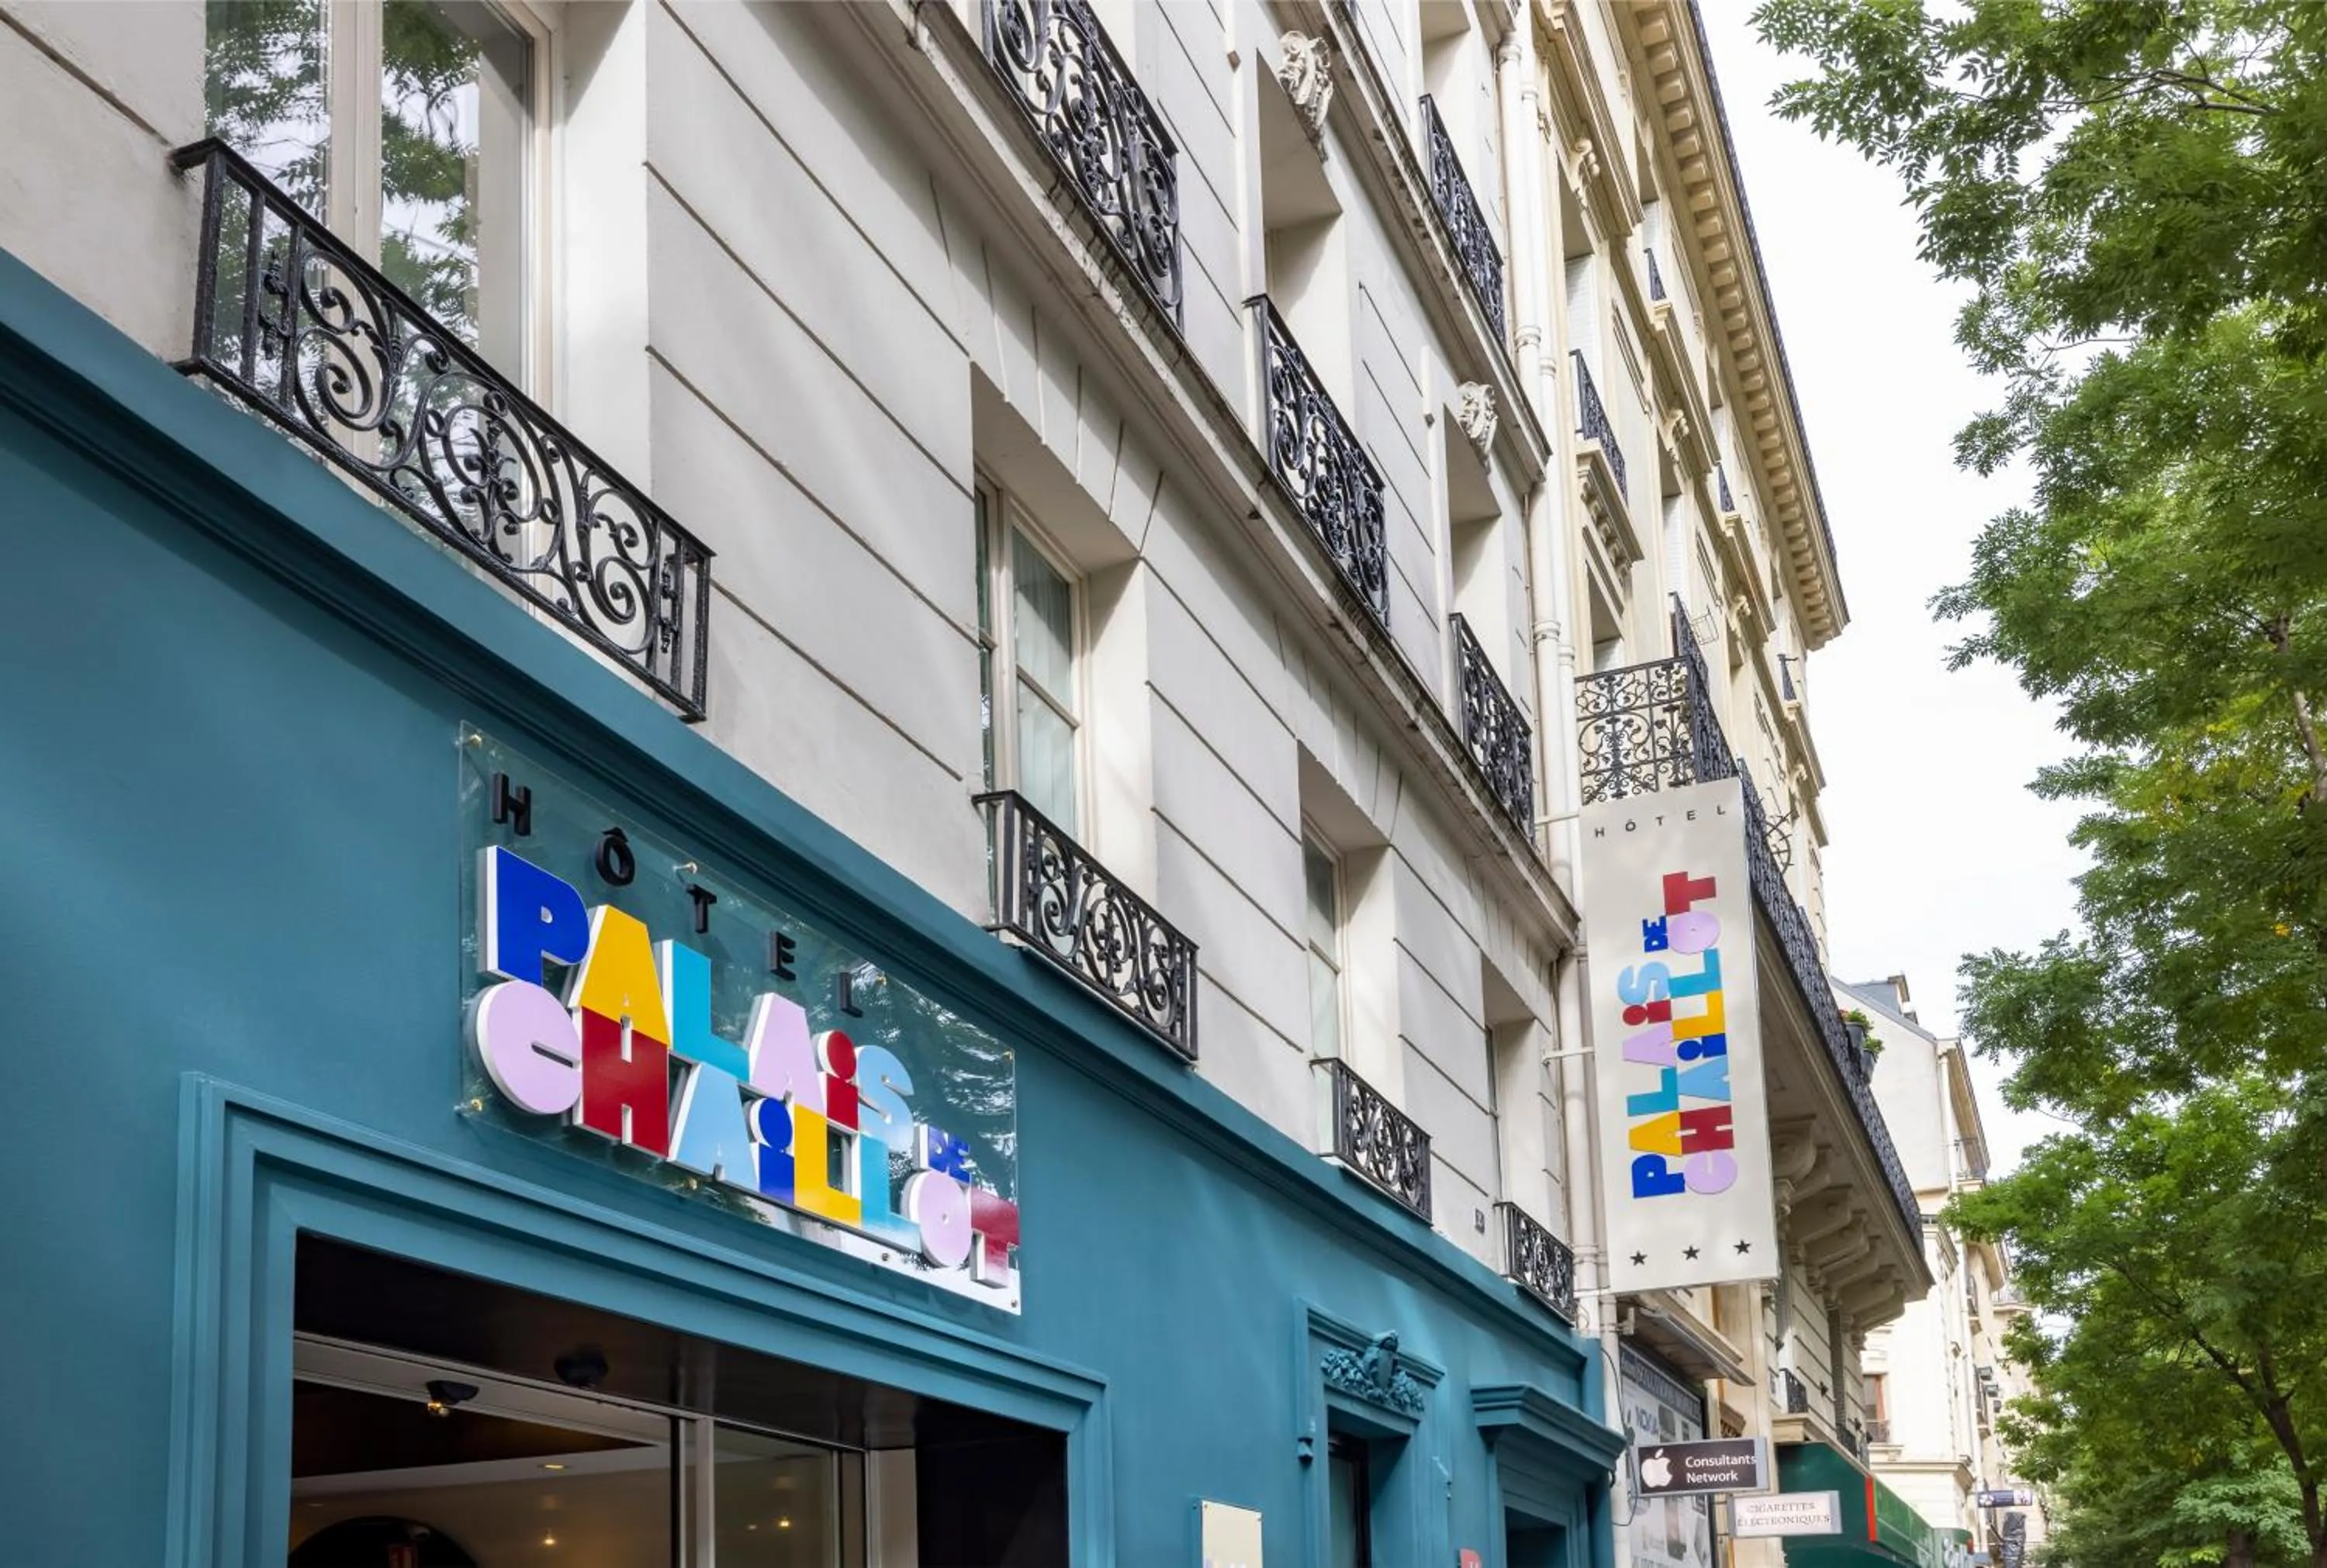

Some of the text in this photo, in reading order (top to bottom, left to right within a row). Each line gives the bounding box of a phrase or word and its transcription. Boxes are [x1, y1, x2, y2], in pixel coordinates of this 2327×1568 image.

[1595, 805, 1726, 838] HÔTEL
[492, 772, 863, 1017] HÔTEL
[1642, 915, 1668, 953] DE
[913, 1124, 970, 1184] DE
[1686, 1455, 1757, 1468] Consultants
[1686, 1470, 1738, 1483] Network
[1746, 1502, 1816, 1513] CIGARETTES
